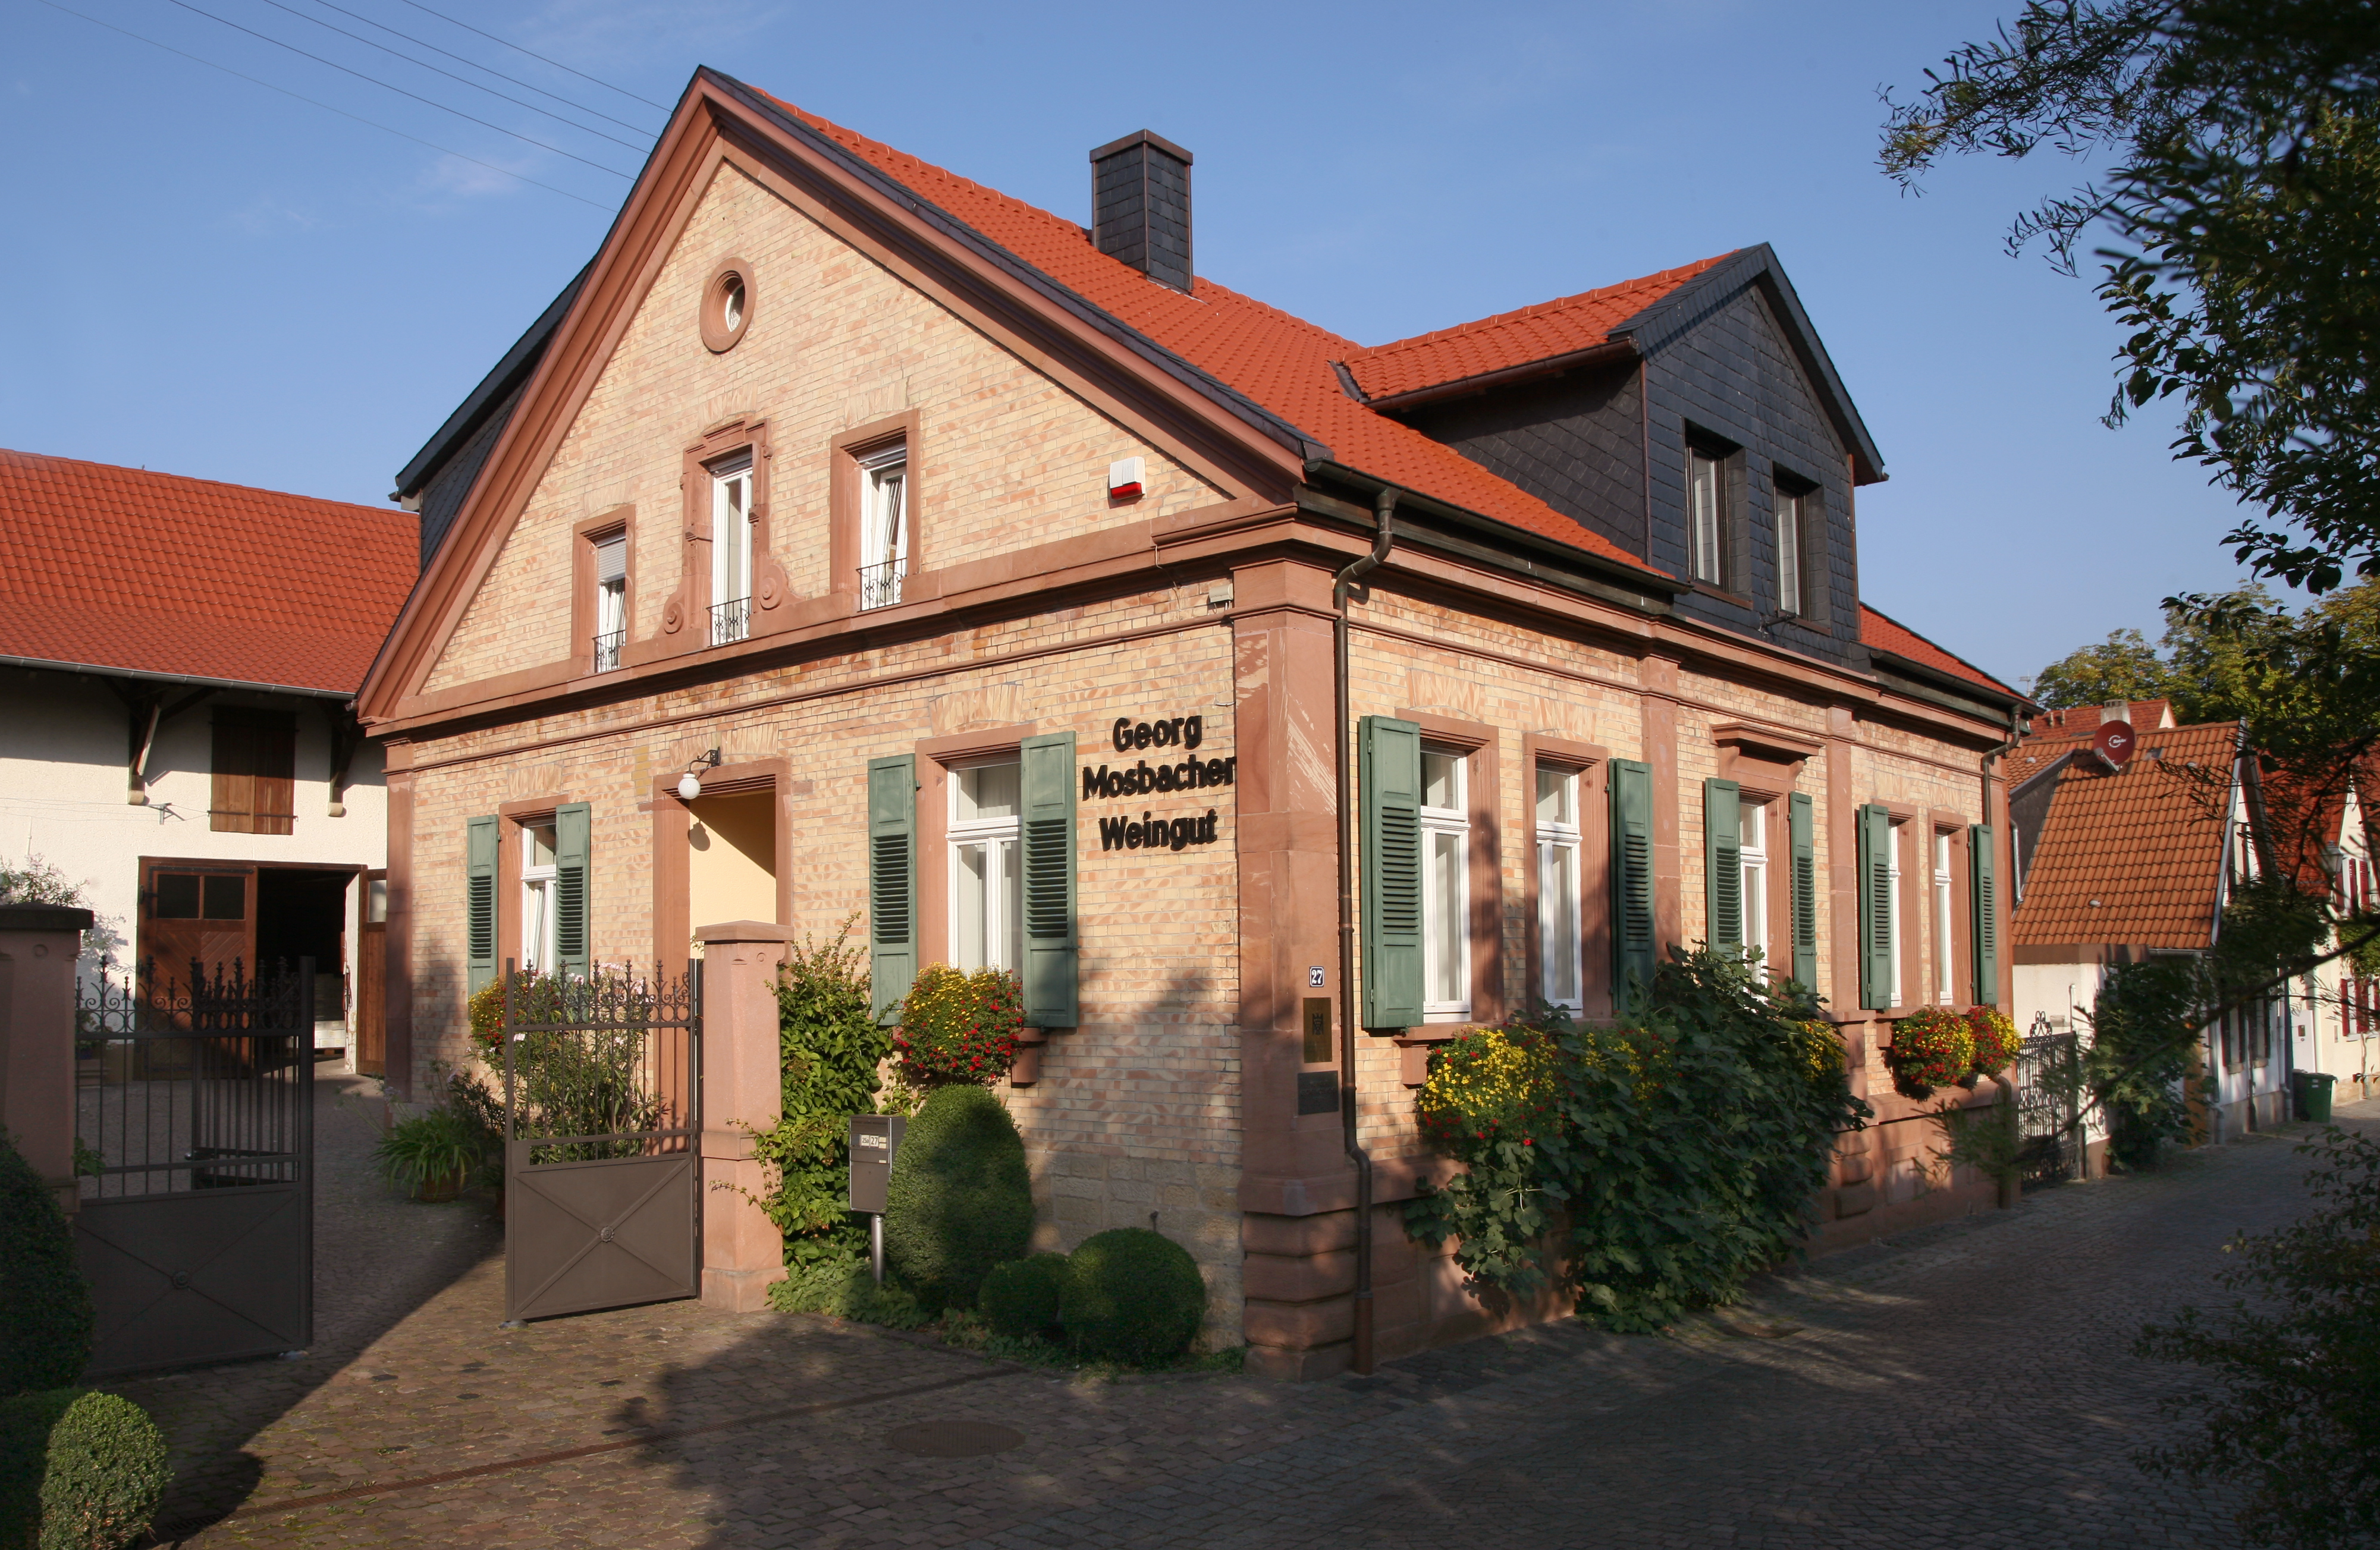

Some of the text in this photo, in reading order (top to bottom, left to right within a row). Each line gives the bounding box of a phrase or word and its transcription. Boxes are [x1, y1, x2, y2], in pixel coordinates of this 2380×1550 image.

[1113, 715, 1202, 752] Georg
[1082, 754, 1237, 801] Mosbacher
[1098, 809, 1217, 851] Weingut
[1312, 970, 1322, 984] 27
[871, 1137, 878, 1145] 27
